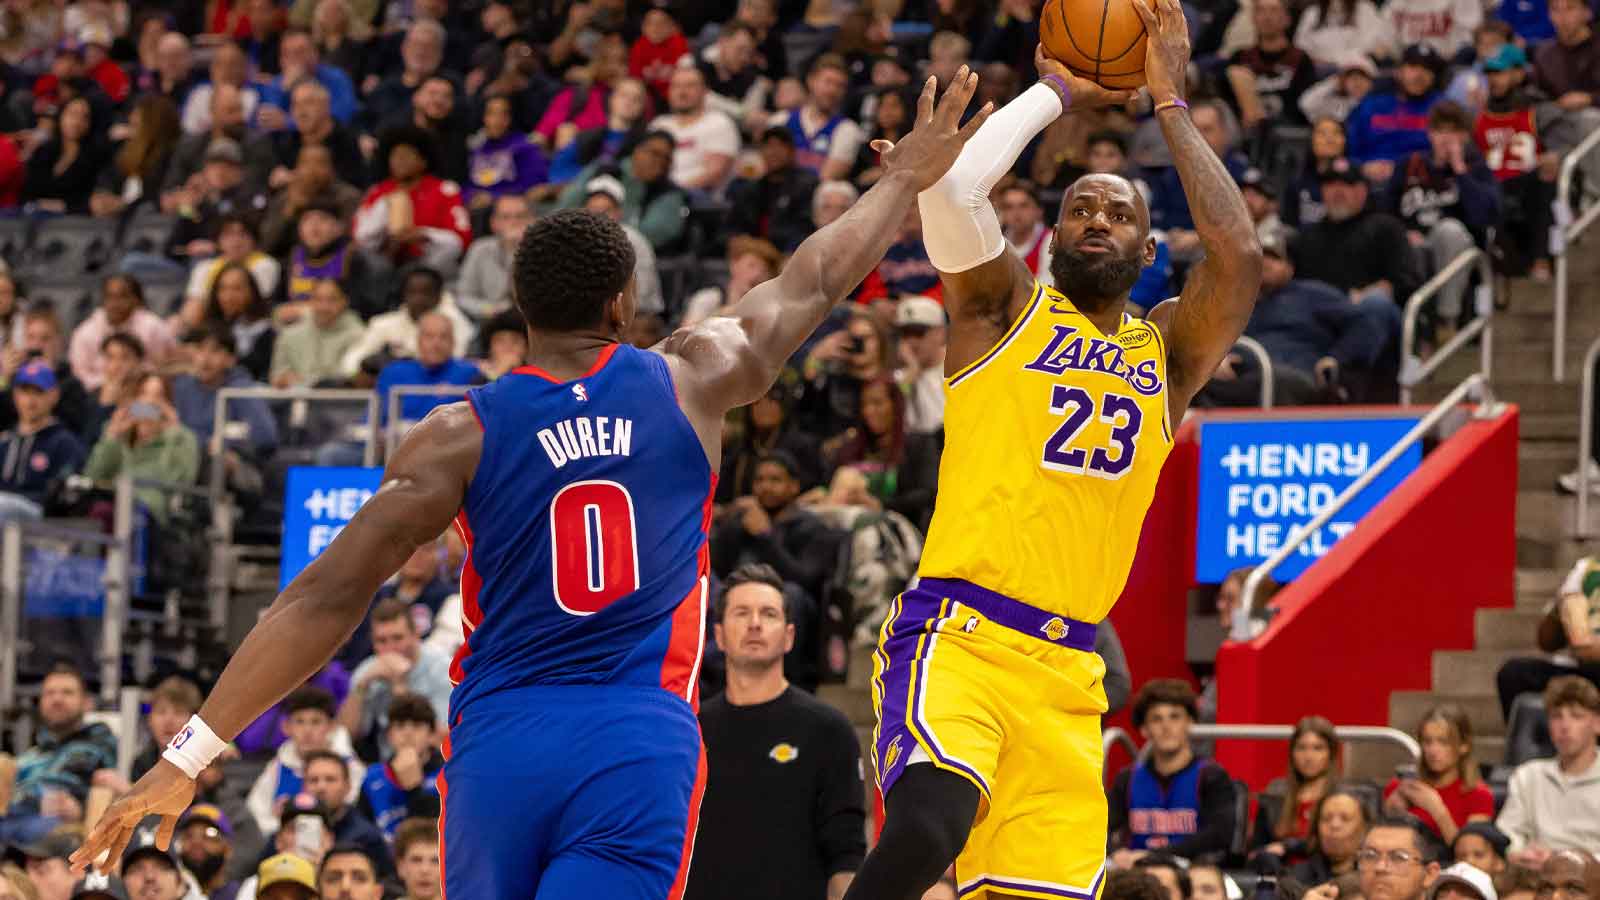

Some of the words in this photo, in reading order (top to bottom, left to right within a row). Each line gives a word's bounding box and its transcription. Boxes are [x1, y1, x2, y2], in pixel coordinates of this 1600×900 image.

[1024, 324, 1162, 396] LAKERS
[537, 416, 632, 469] DUREN
[1041, 384, 1144, 480] 23
[1220, 442, 1370, 478] HENRY
[1228, 482, 1336, 518] FORD
[551, 479, 640, 616] 0
[1226, 522, 1357, 558] HEALT
